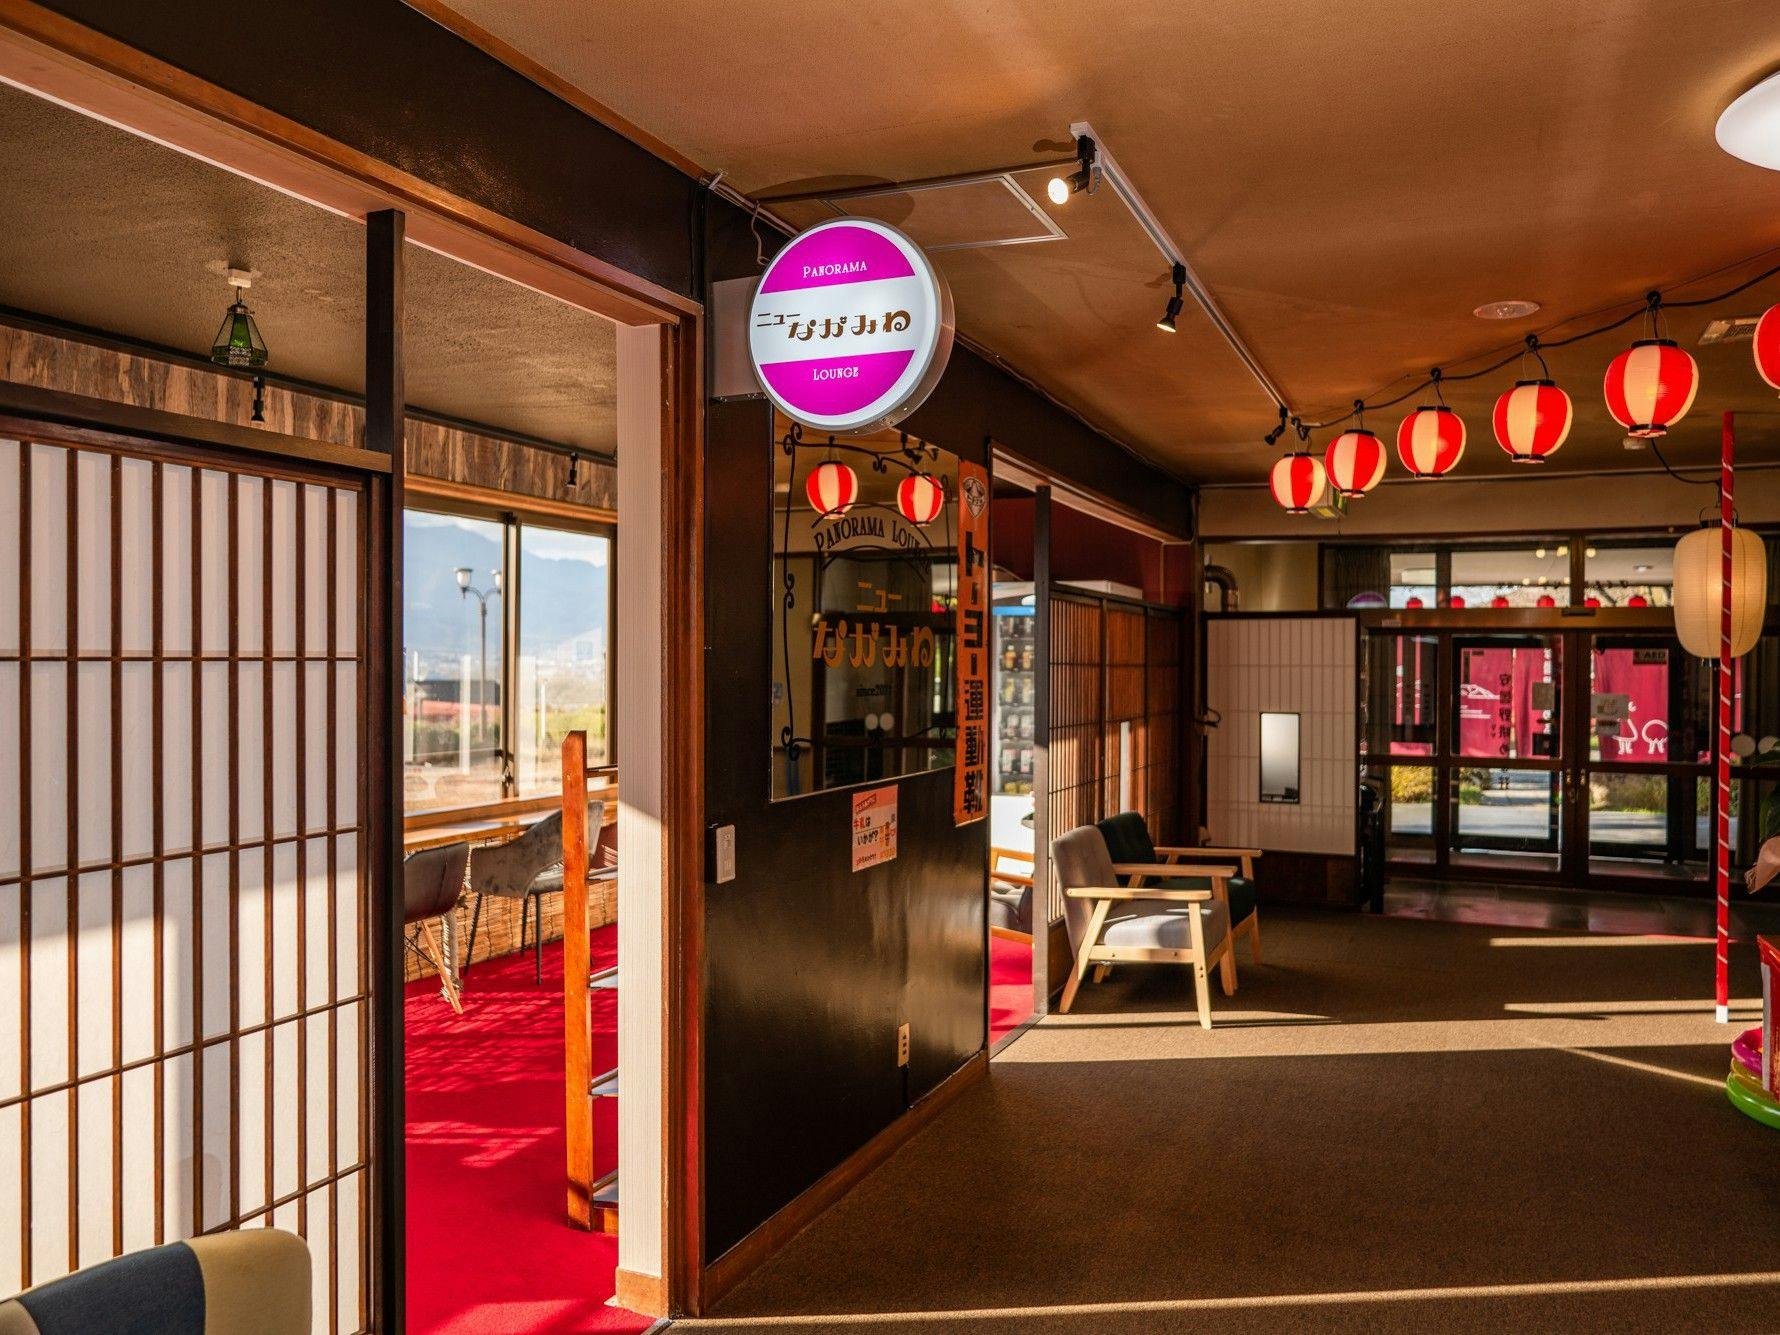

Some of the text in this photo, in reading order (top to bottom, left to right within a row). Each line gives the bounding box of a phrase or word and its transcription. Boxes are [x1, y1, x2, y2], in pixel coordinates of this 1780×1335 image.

[802, 261, 867, 278] PANORAMA
[813, 366, 859, 381] LOUNGE
[814, 516, 885, 549] PANORAMA
[856, 581, 904, 613] ニュー
[812, 619, 934, 669] ながみね
